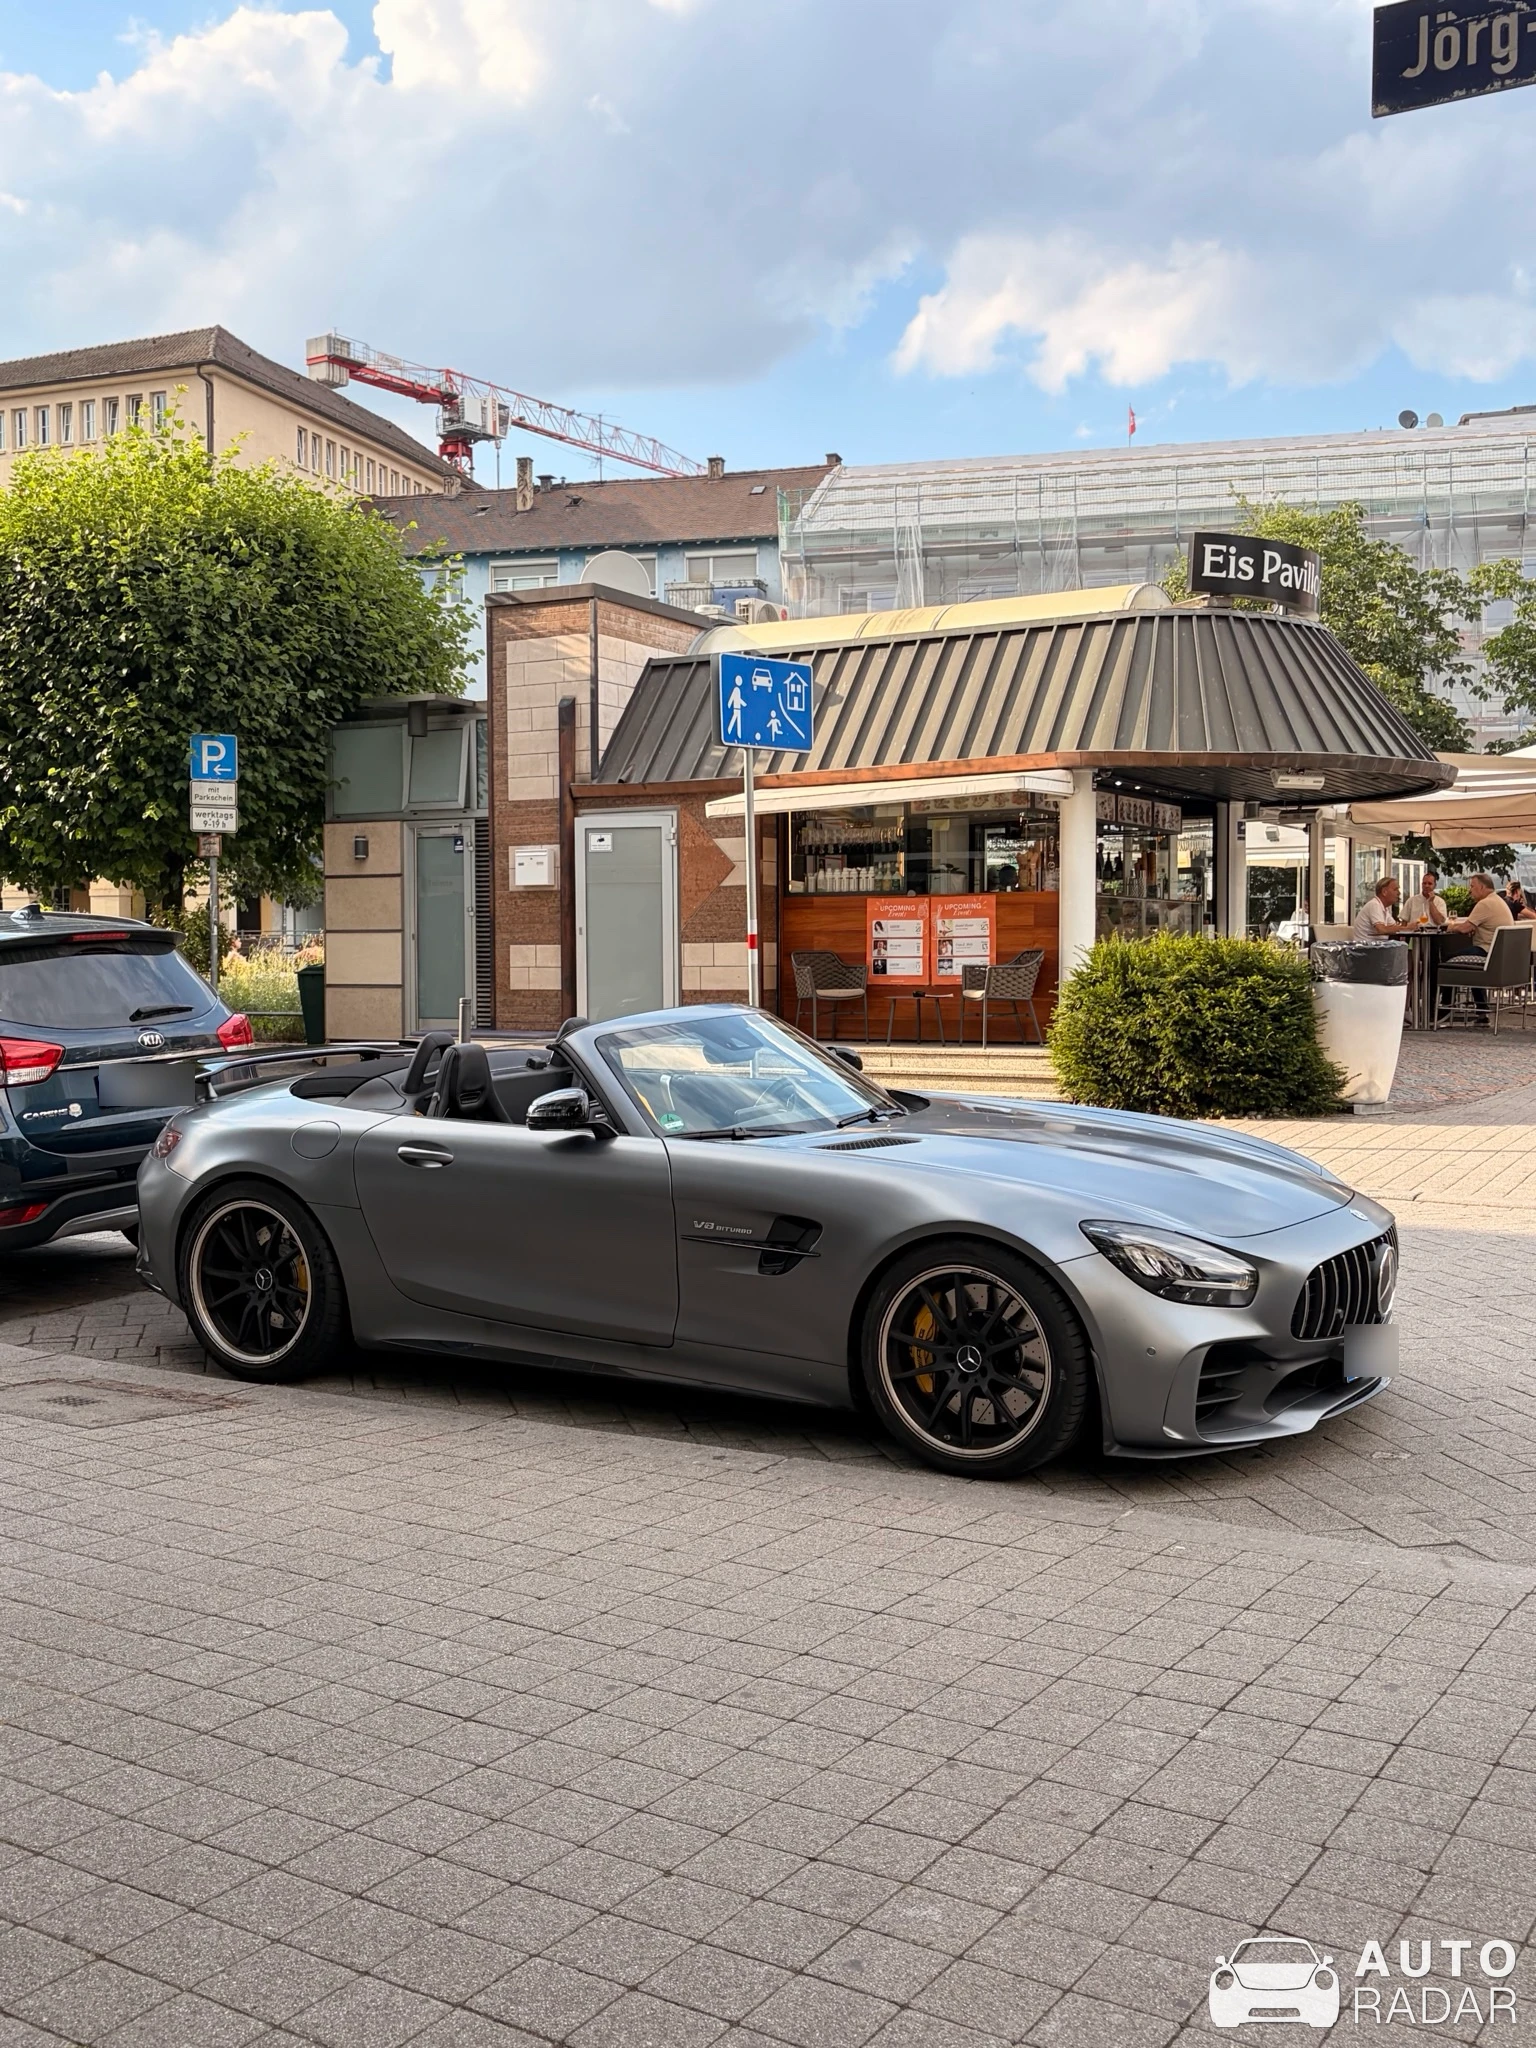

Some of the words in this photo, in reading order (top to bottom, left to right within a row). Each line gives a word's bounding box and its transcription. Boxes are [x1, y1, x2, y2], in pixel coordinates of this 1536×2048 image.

[1202, 543, 1255, 581] Eis
[202, 740, 226, 774] P
[194, 793, 234, 802] Parkschein
[194, 811, 234, 821] werktags
[203, 819, 220, 828] 9-19
[880, 904, 916, 912] UPCOMING
[944, 902, 982, 910] UPCOMING
[143, 1034, 162, 1046] KIA
[693, 1220, 715, 1230] V8
[715, 1225, 753, 1235] BITURBO
